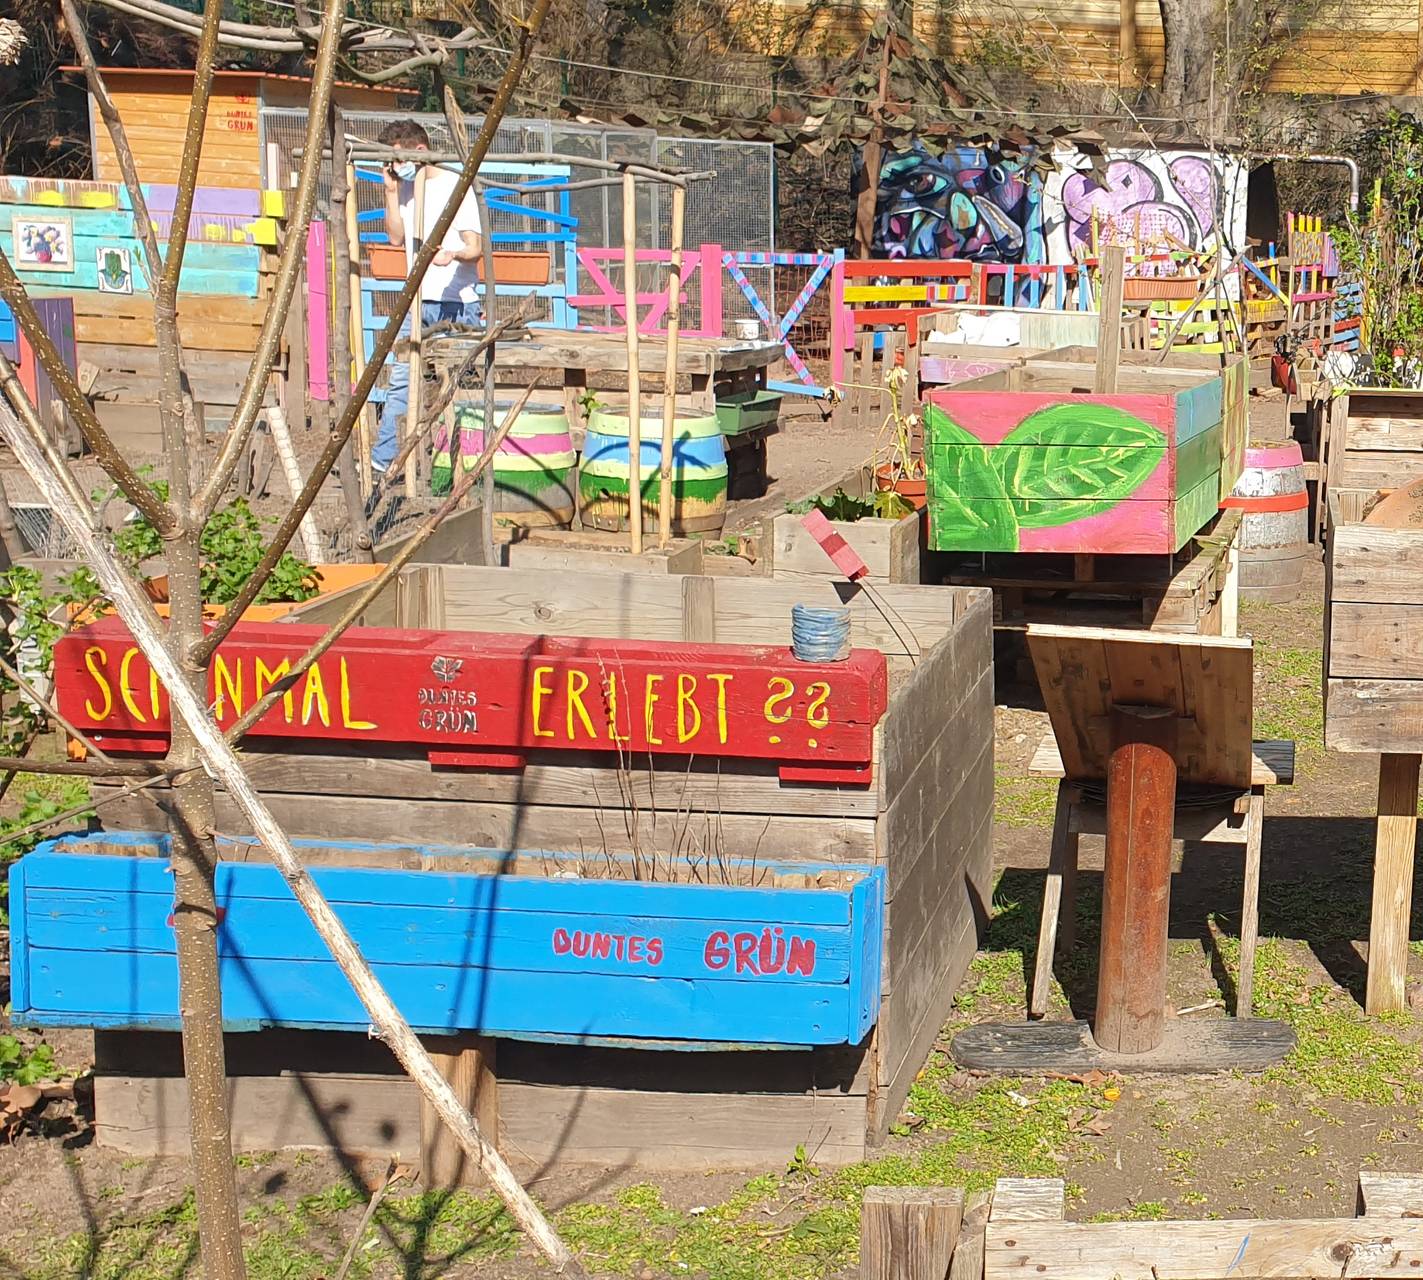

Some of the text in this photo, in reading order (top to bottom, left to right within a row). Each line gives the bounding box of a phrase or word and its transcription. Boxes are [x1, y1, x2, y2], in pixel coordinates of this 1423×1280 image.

[418, 706, 478, 733] GRÜN
[531, 666, 734, 746] ERLEBT
[703, 927, 817, 977] GRÜN
